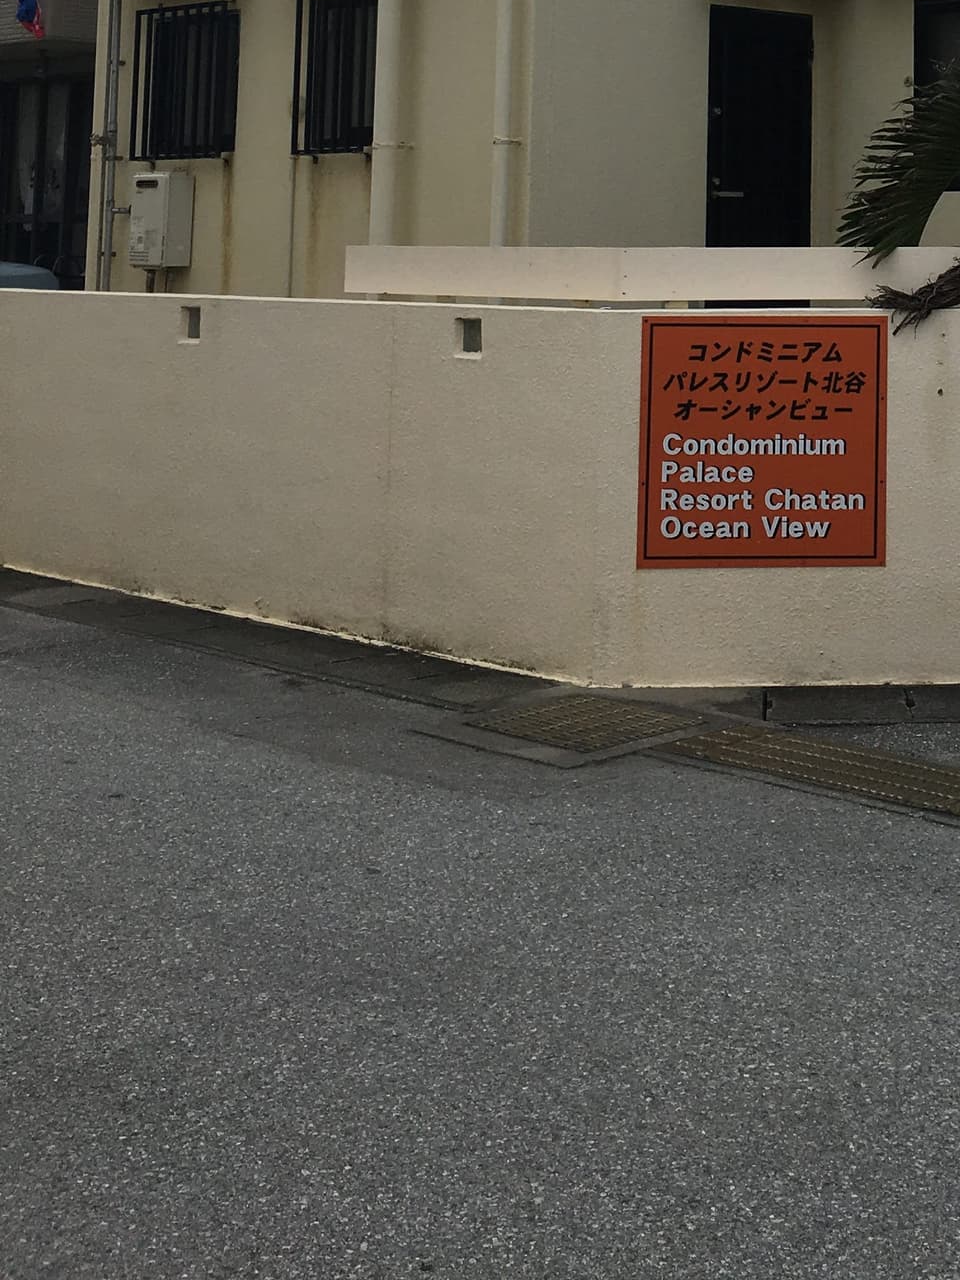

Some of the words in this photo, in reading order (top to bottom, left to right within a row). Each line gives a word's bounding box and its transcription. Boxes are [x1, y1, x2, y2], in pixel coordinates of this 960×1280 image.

[688, 341, 842, 363] コンドミニアム
[663, 371, 867, 393] パレスリゾート北谷
[674, 399, 853, 420] オーシャンビュー
[662, 433, 846, 456] Condominium
[660, 461, 754, 483] Palace
[660, 489, 753, 511] Resort
[764, 488, 865, 511] Chatan
[660, 516, 750, 538] Ocean
[761, 516, 830, 538] View
